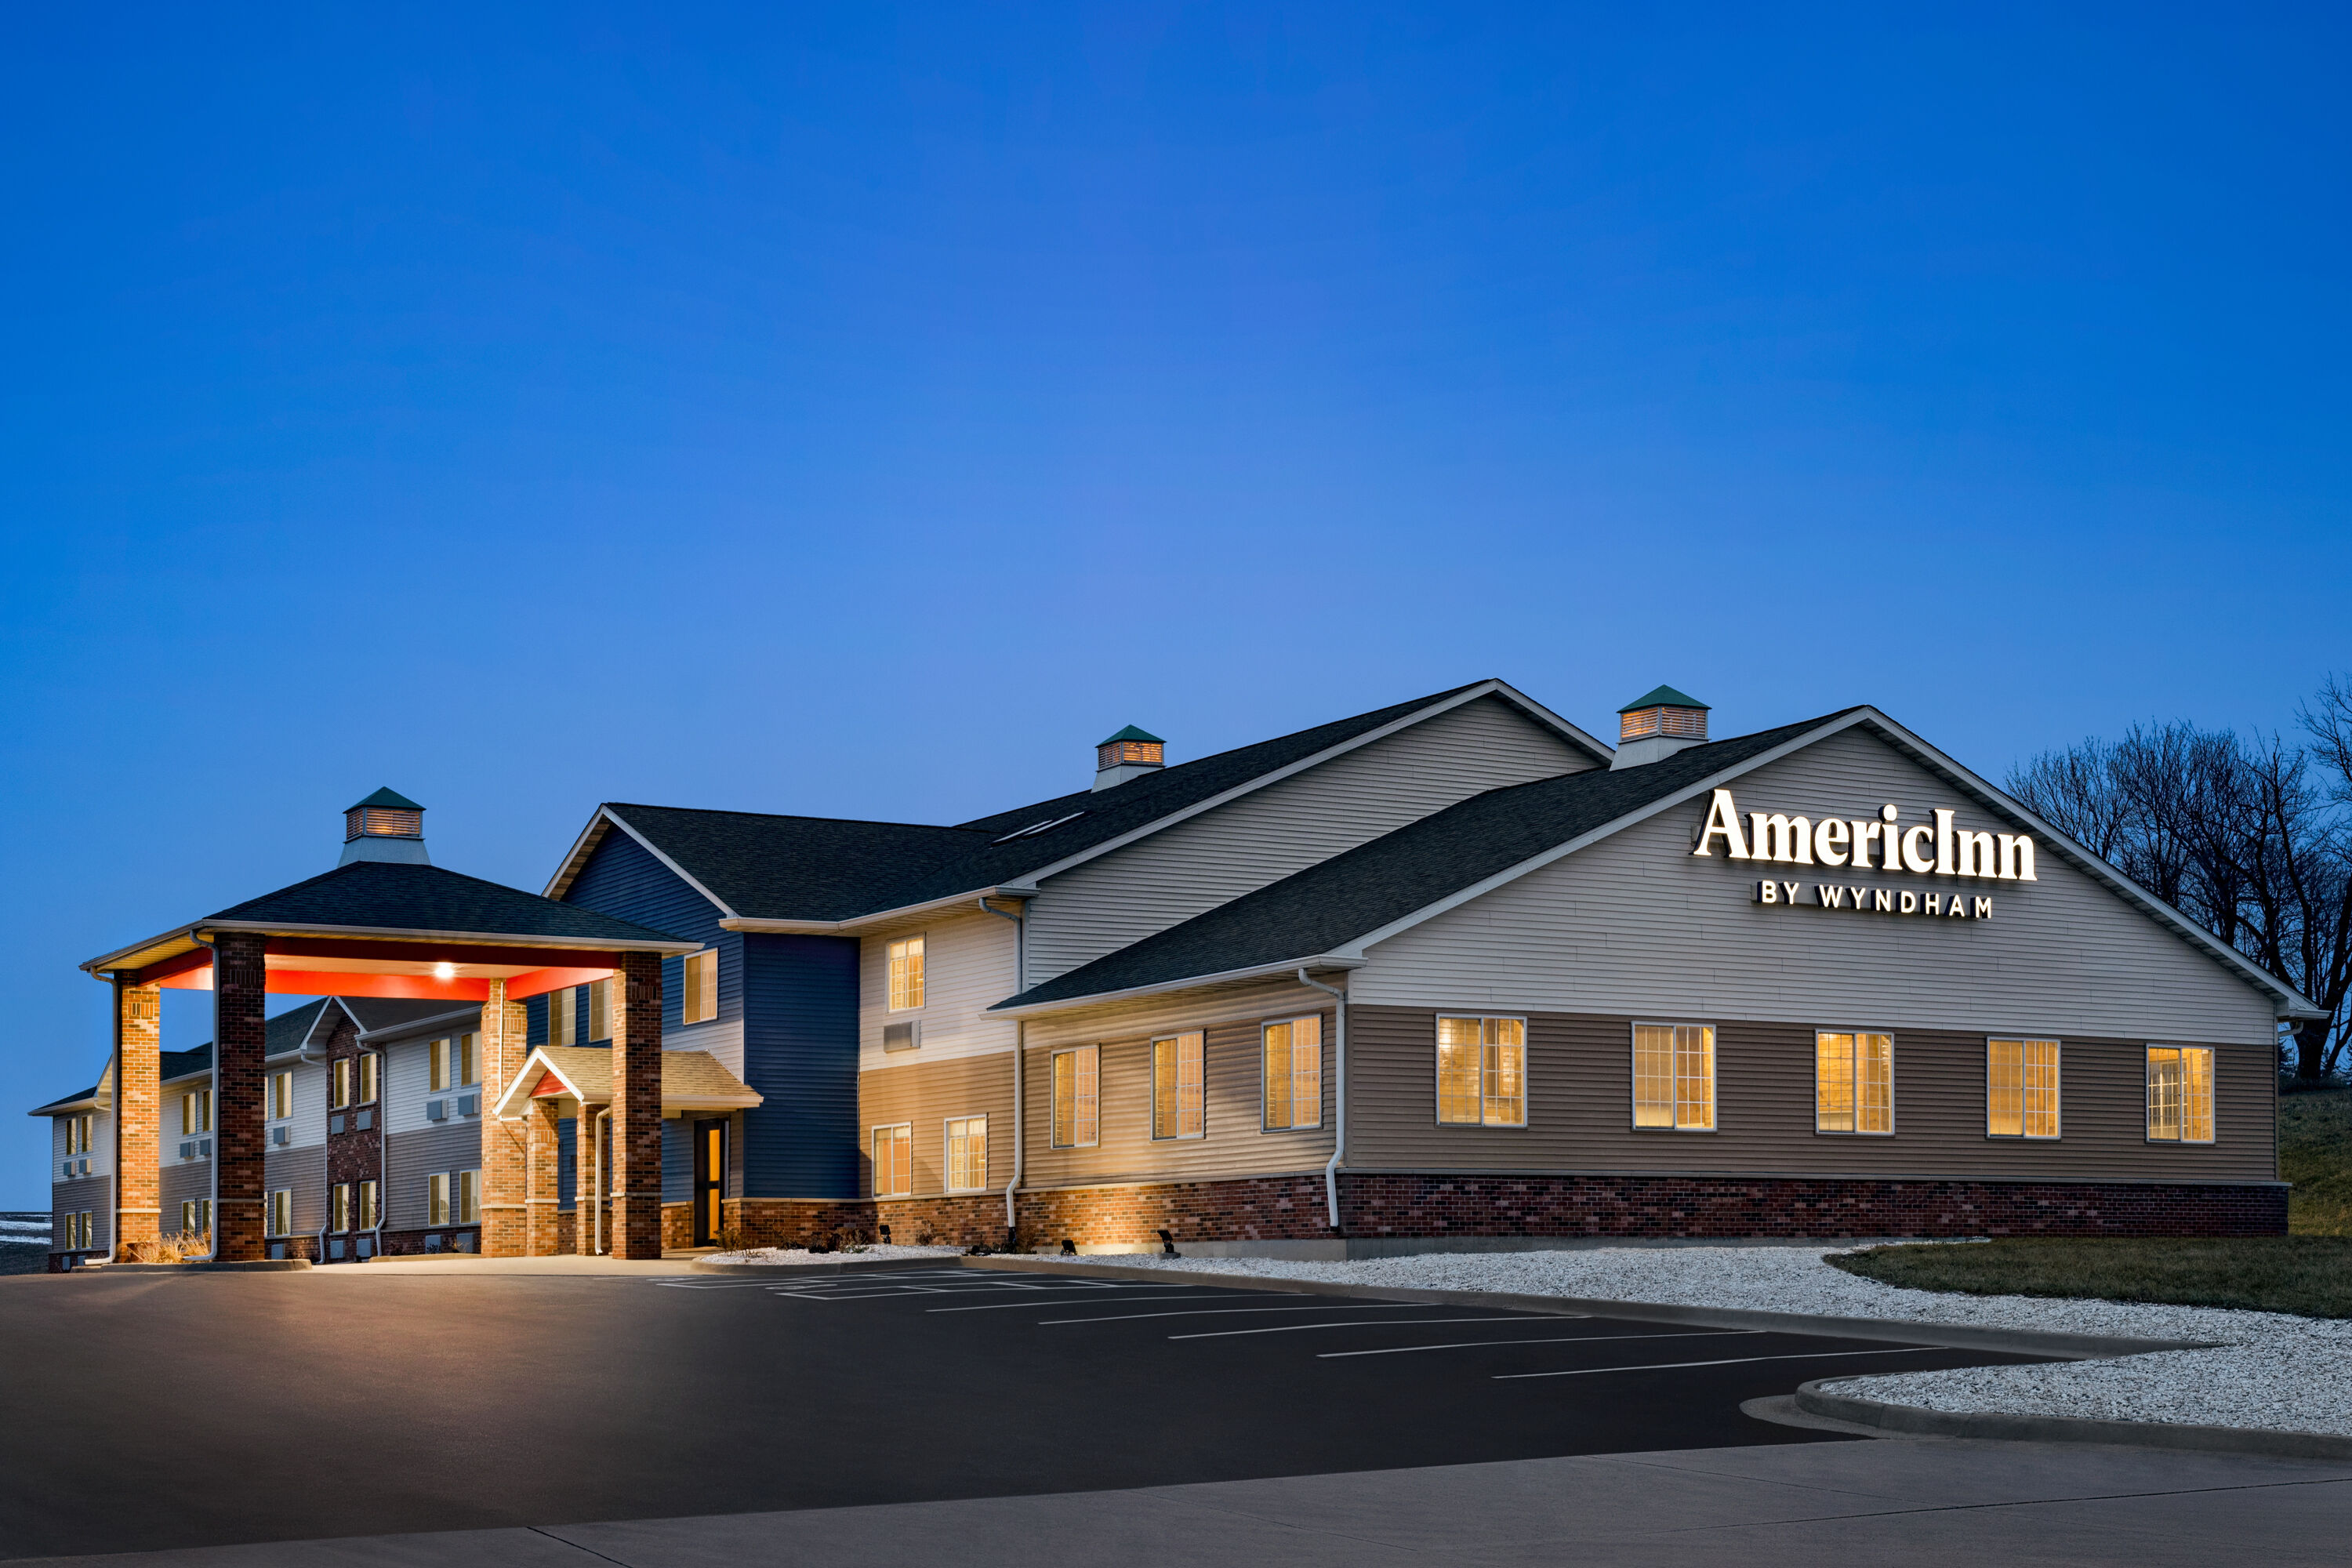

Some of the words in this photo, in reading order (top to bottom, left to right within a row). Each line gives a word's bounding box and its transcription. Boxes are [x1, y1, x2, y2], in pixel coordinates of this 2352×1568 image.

[1693, 789, 2038, 881] AmericInn
[1759, 880, 1799, 905] BY
[1817, 884, 1992, 919] WYNDHAM
